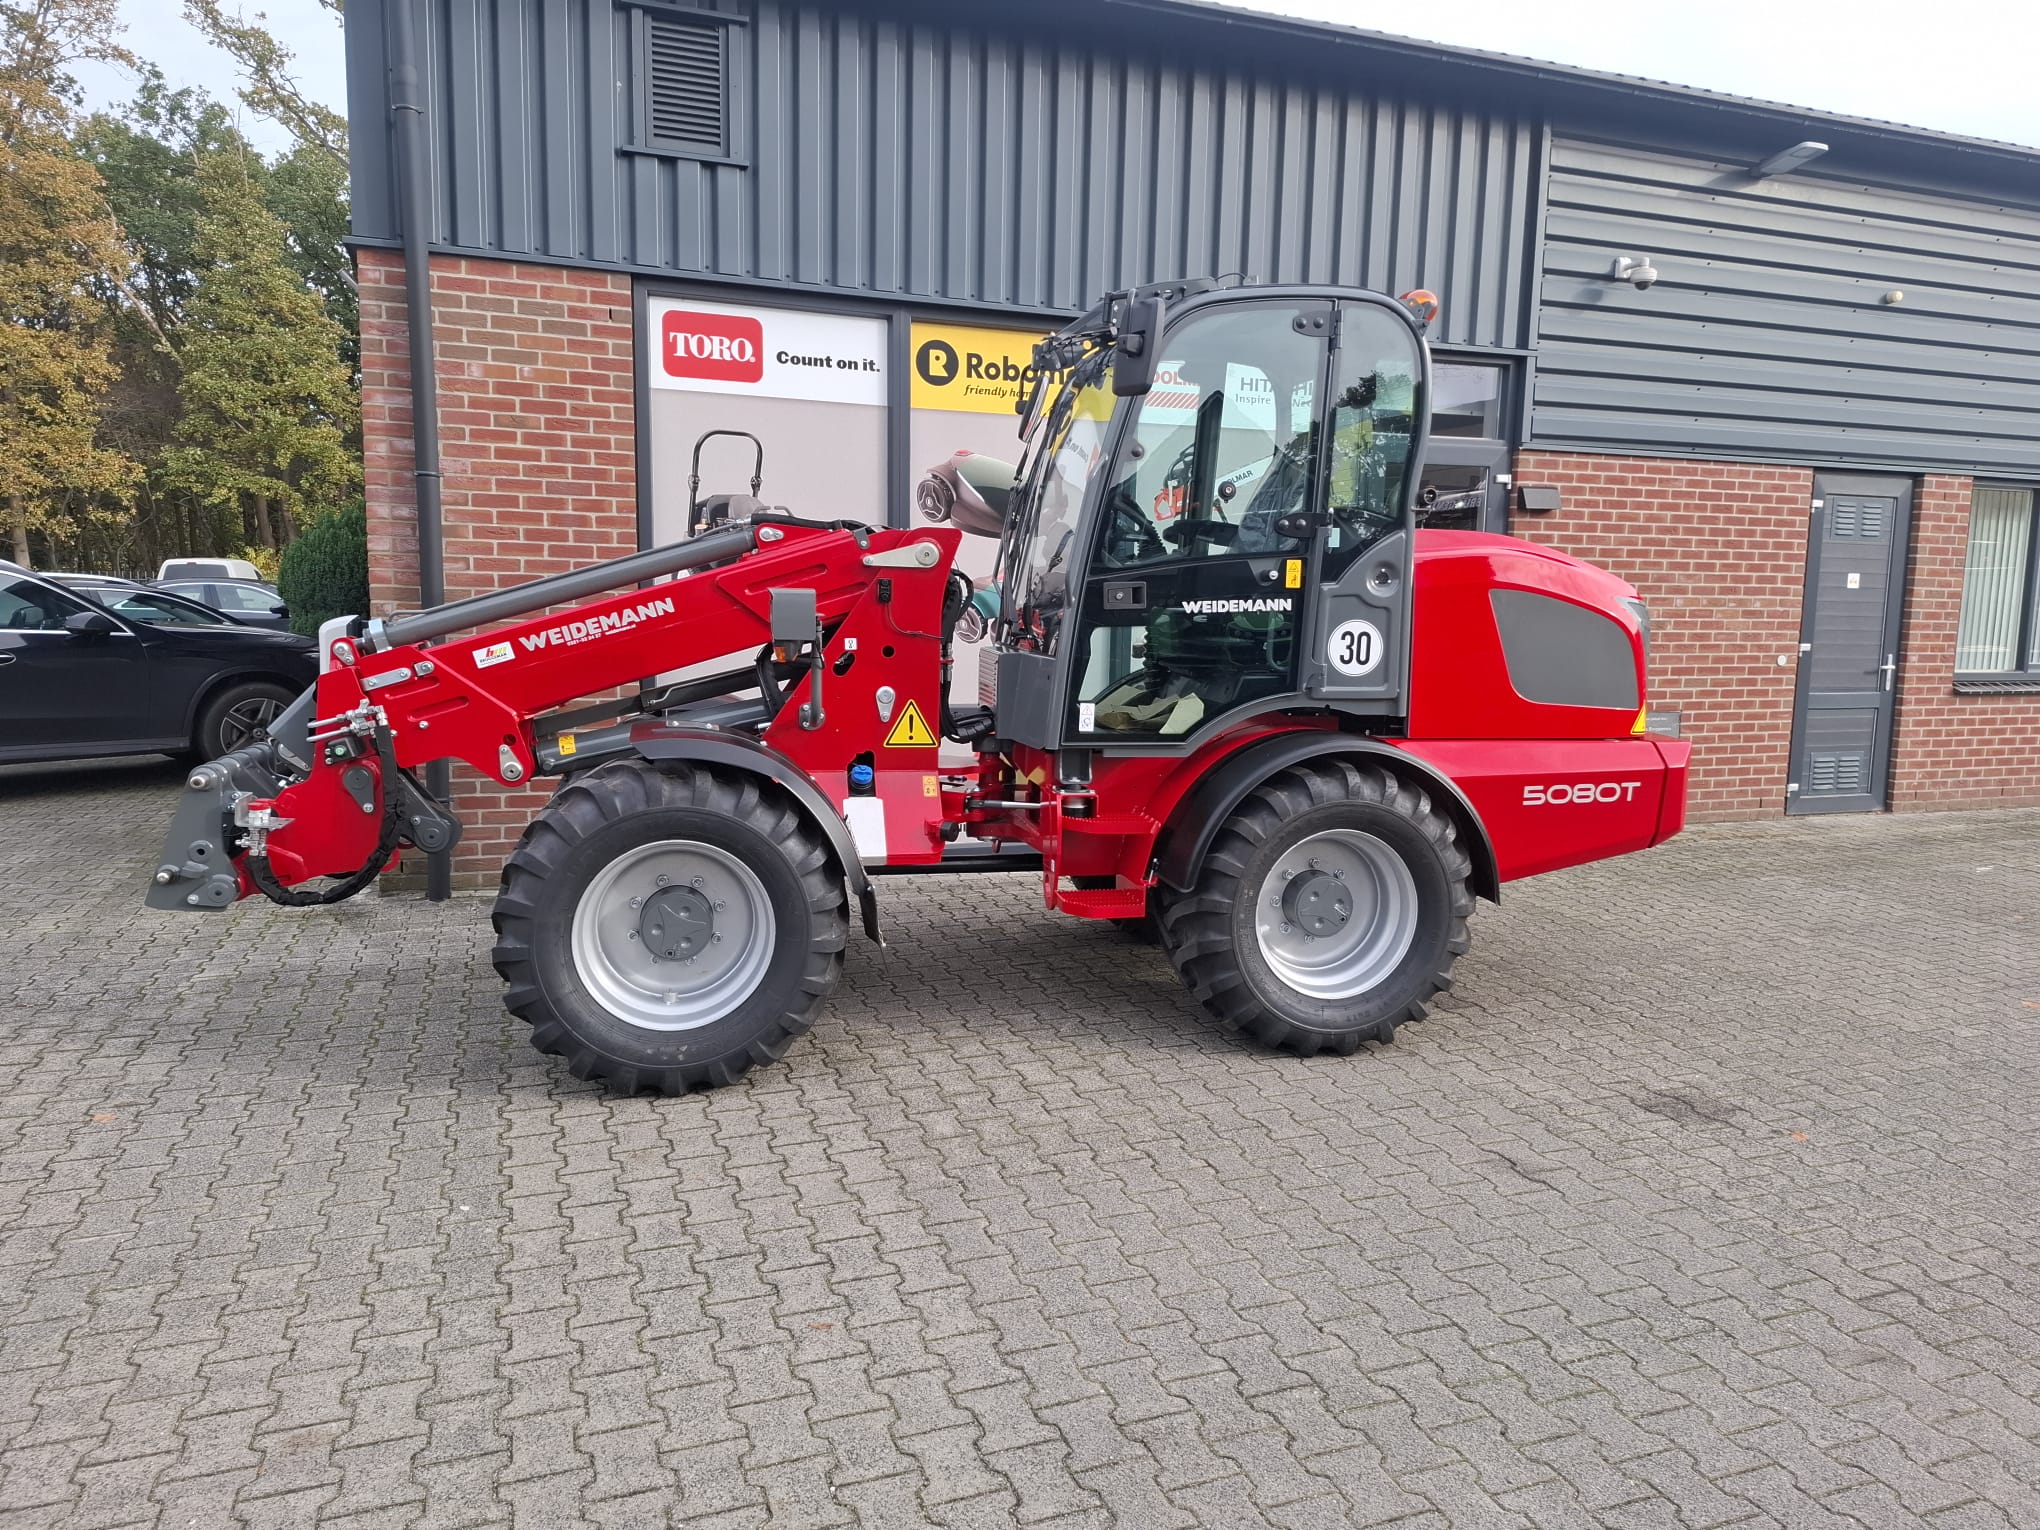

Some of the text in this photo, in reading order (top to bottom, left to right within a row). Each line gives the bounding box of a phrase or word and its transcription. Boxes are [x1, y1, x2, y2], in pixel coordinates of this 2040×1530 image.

[776, 351, 881, 373] Count on it.
[966, 352, 1074, 385] Robom
[963, 385, 1031, 399] friendly hom
[1235, 393, 1272, 407] Inspire
[1182, 598, 1292, 614] WEIDEMANN
[518, 597, 676, 652] WEIDEMANN
[1339, 630, 1372, 666] 30
[1522, 781, 1642, 806] 5080T
